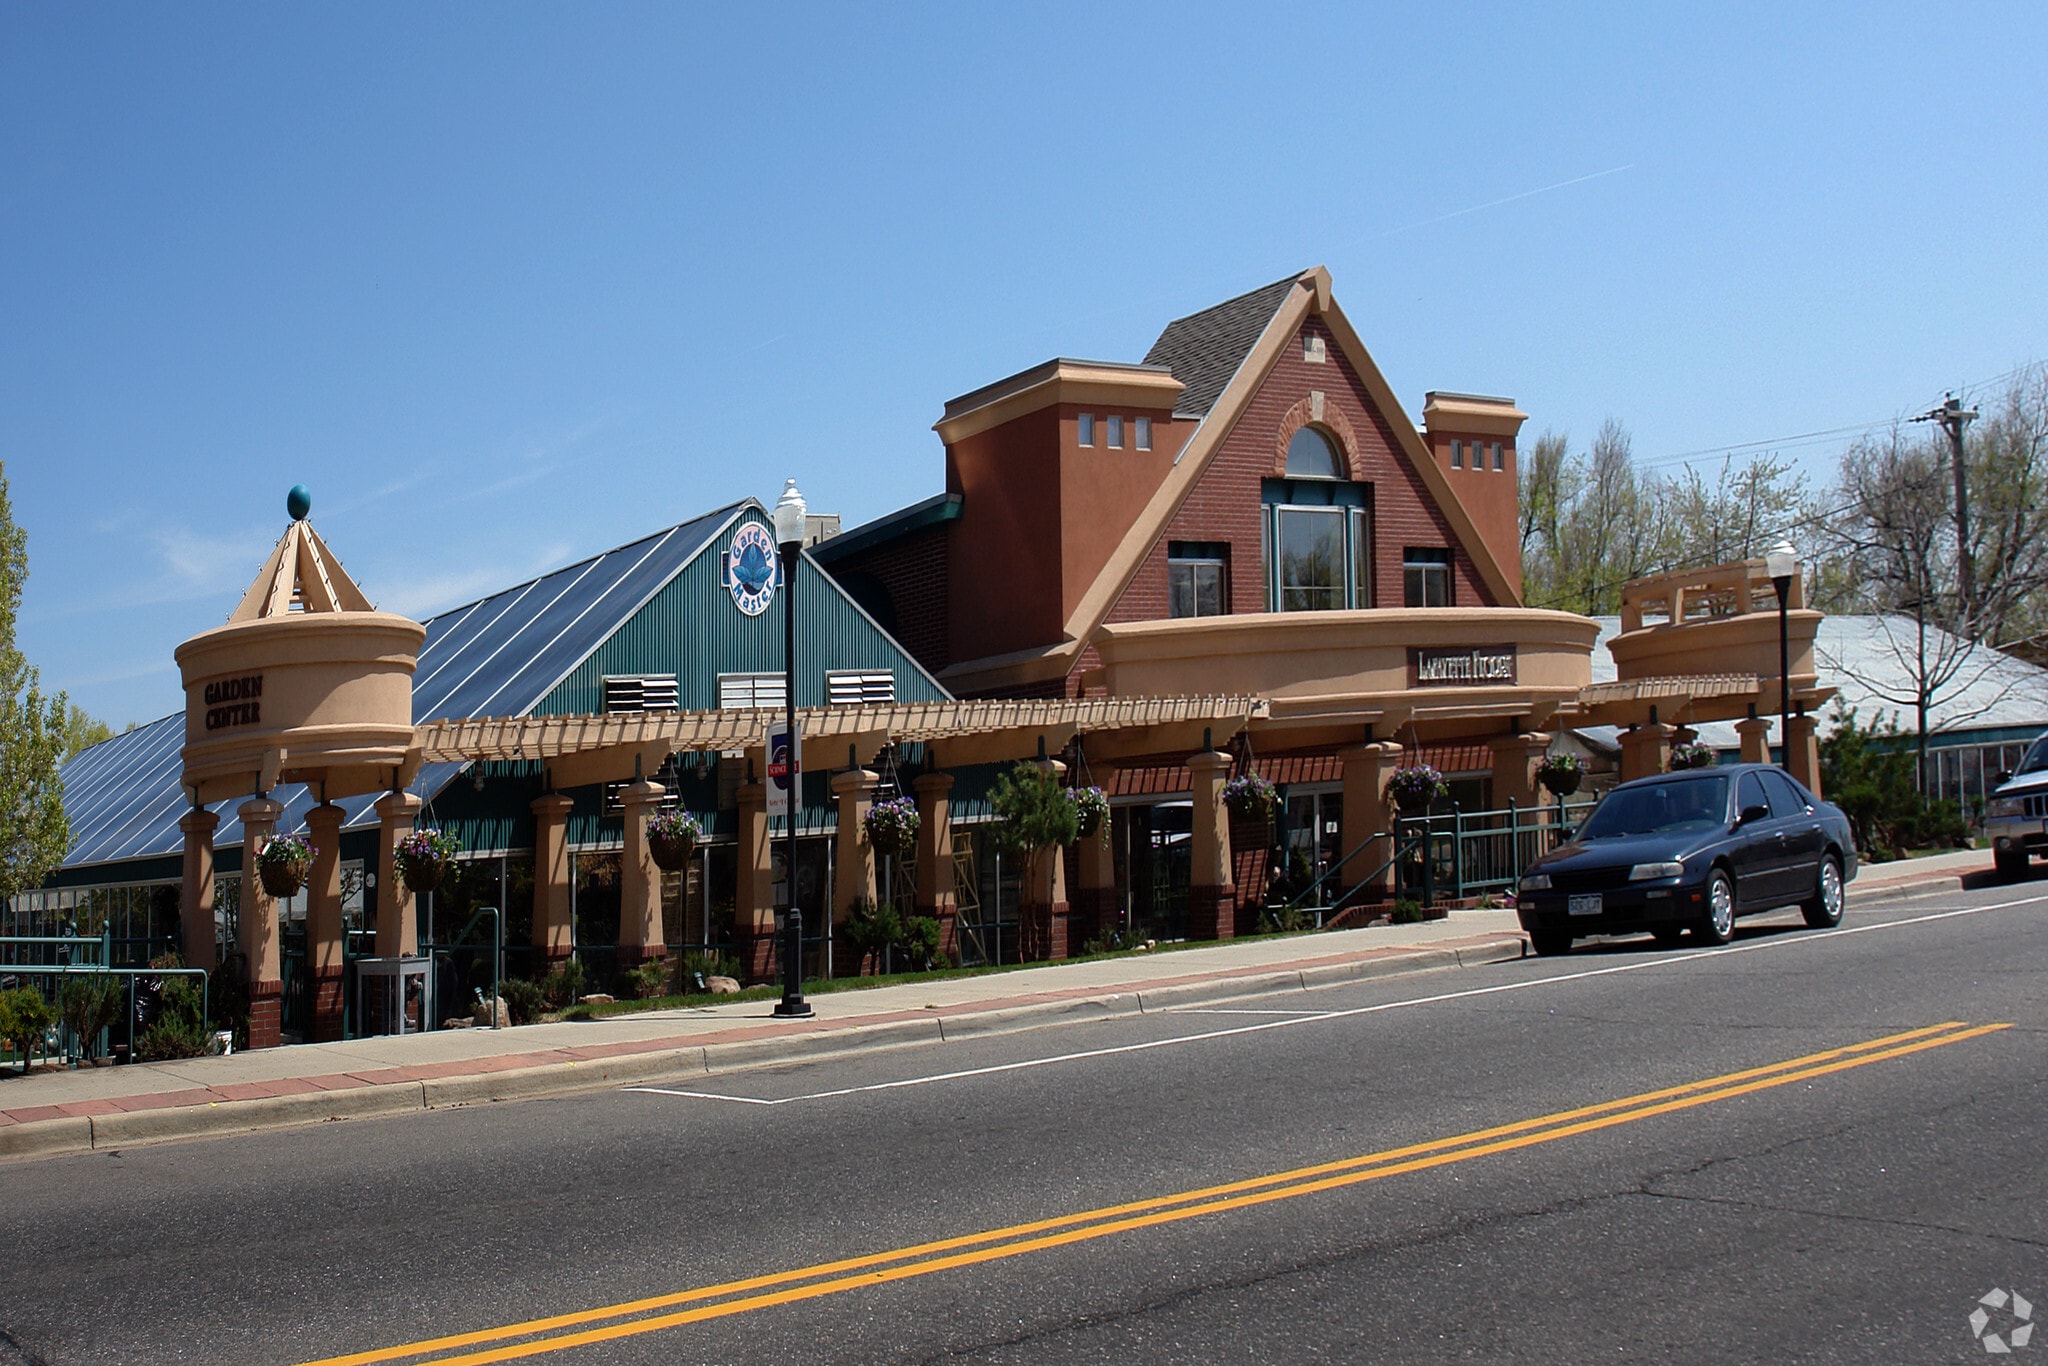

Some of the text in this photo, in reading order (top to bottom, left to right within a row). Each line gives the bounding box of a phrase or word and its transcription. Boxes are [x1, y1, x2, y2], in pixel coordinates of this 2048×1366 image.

[733, 529, 772, 560] Garden
[733, 580, 773, 612] Master
[204, 675, 263, 706] GARDEN
[206, 701, 260, 730] CENTER
